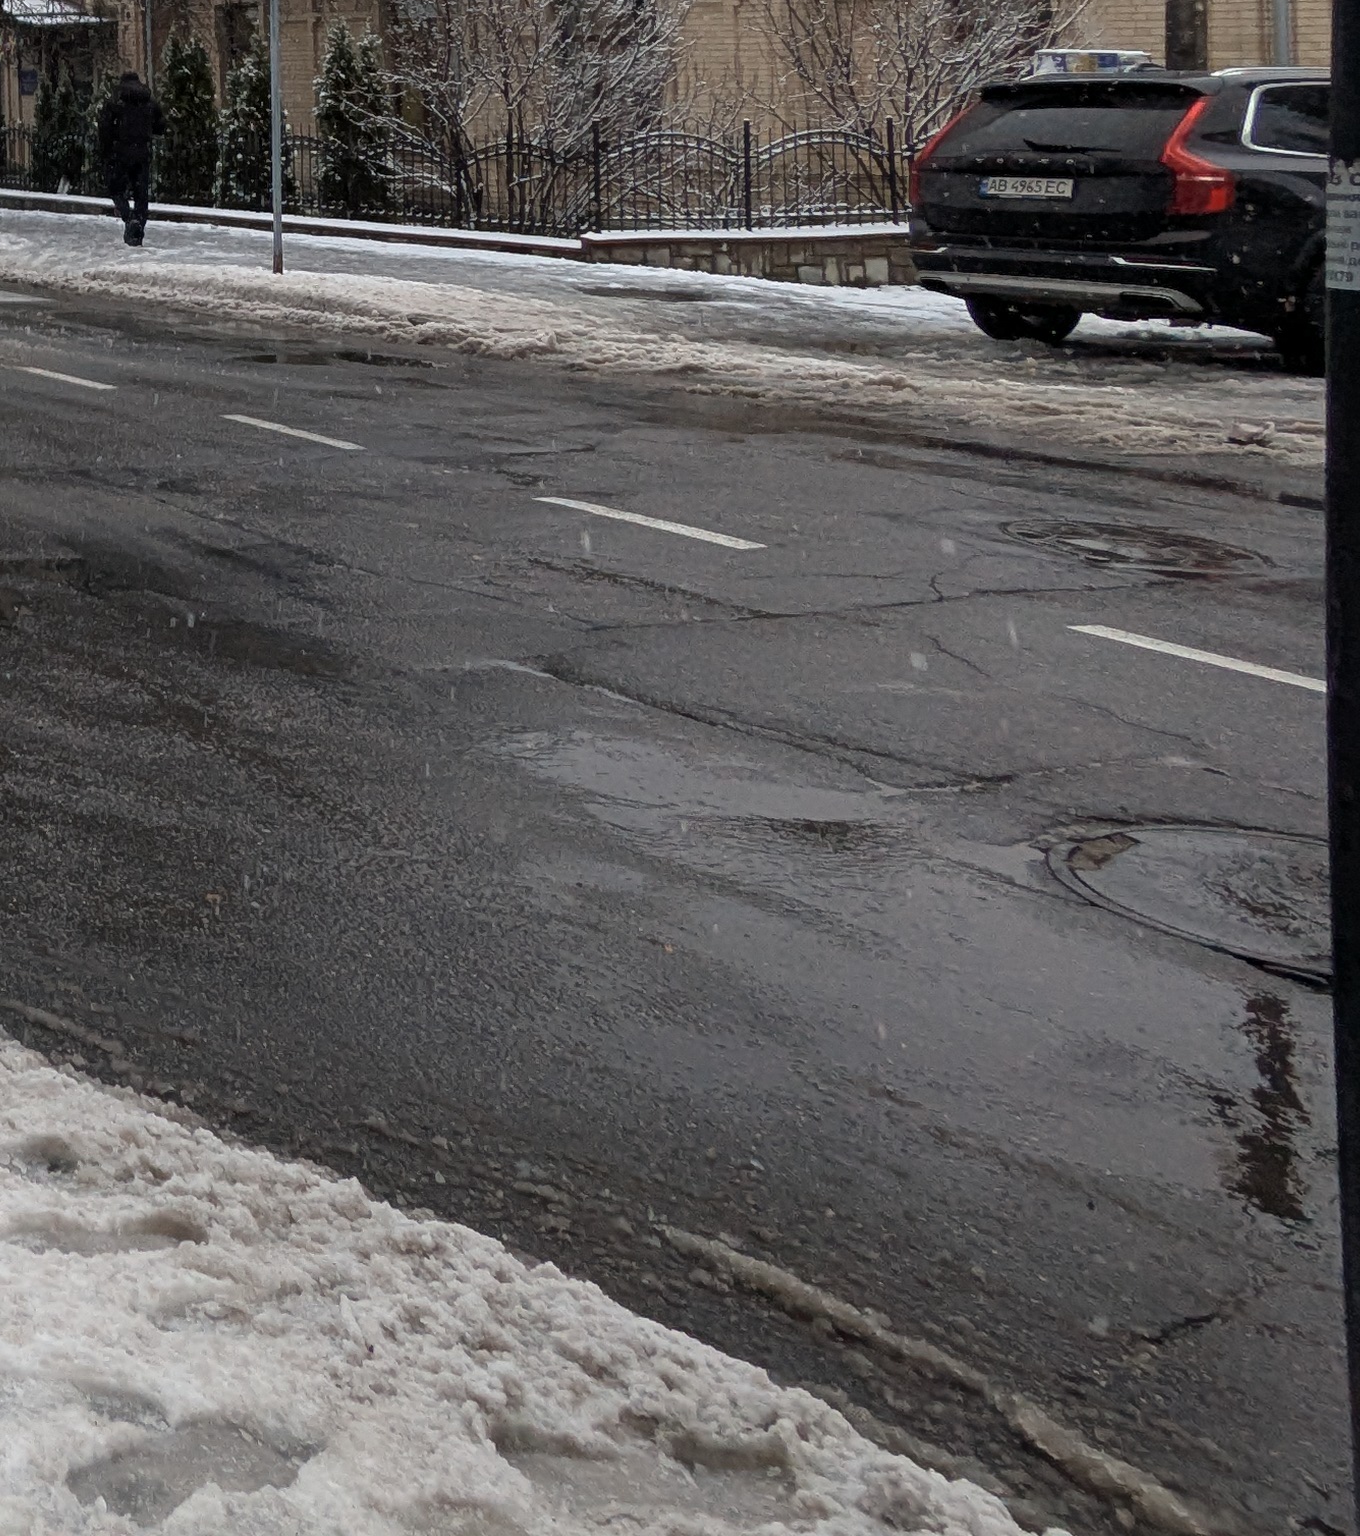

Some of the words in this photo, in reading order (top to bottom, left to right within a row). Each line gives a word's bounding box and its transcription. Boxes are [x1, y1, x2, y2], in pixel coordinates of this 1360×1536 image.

[988, 179, 1008, 192] AB
[1011, 179, 1043, 194] 4965
[1044, 180, 1068, 195] EC
